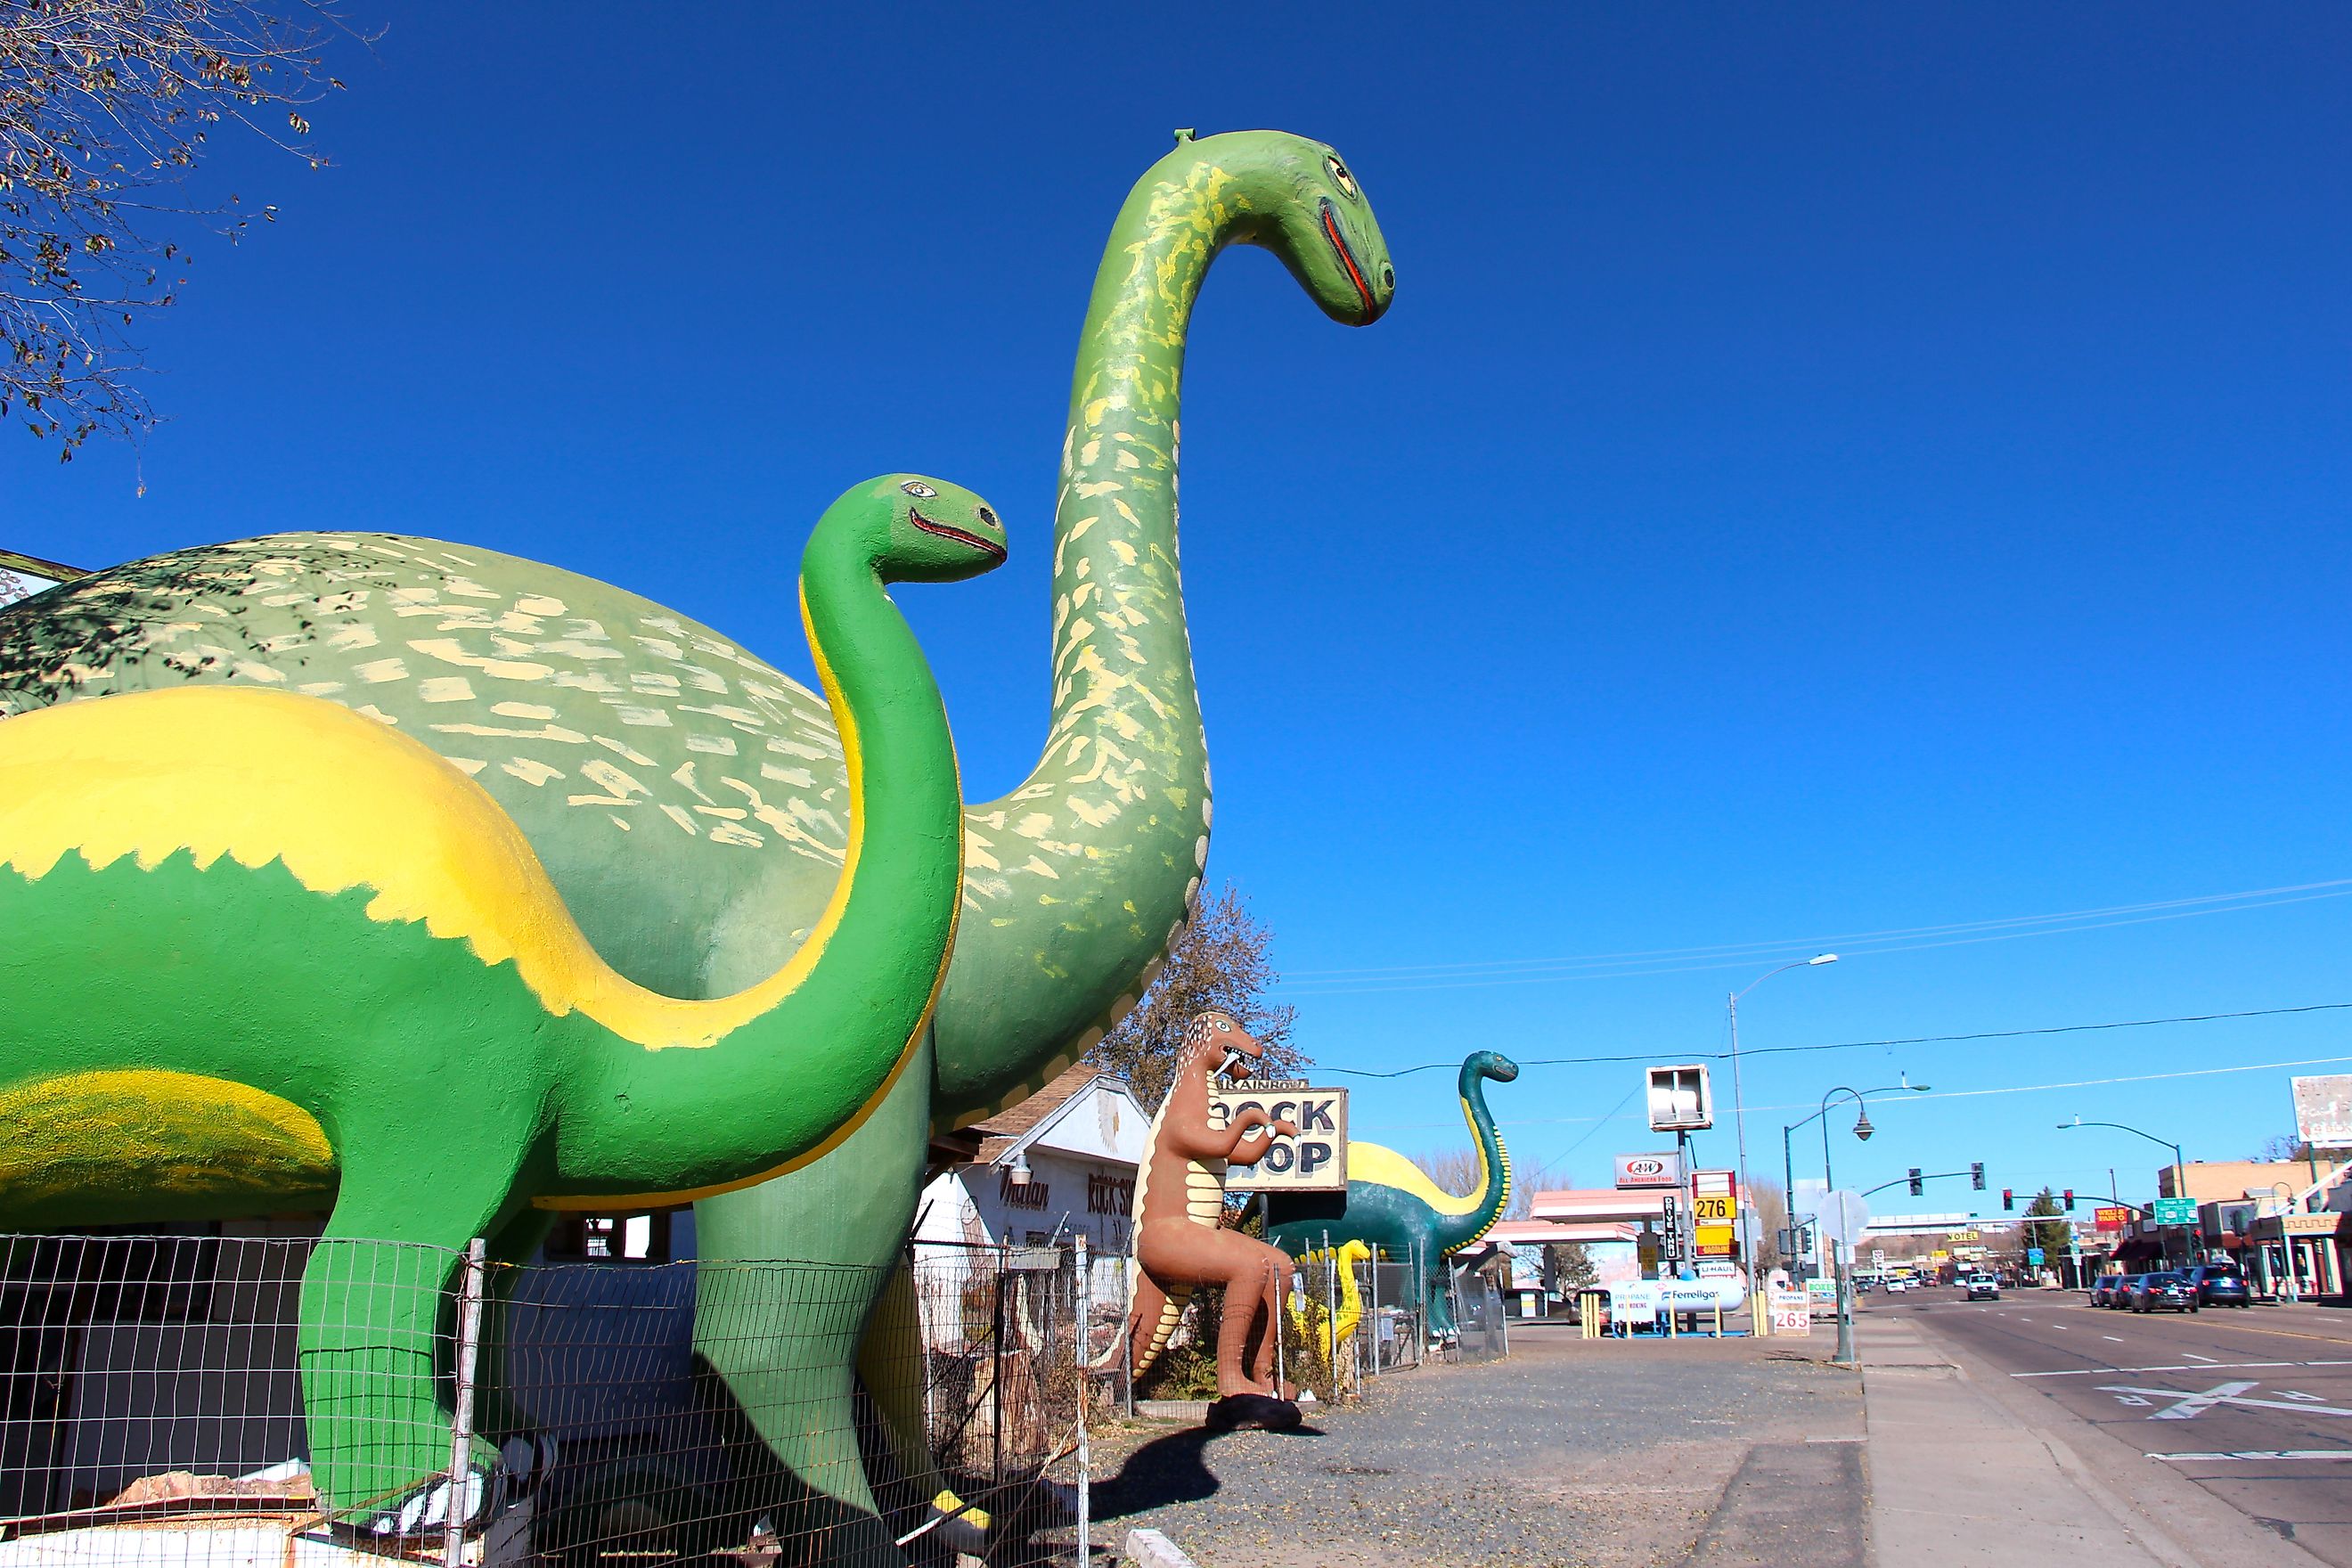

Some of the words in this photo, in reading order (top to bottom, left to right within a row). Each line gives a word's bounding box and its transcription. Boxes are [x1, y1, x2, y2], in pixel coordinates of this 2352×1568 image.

[1225, 1079, 1303, 1090] RAINBOW
[1664, 1196, 1674, 1229] DRIVE
[1696, 1199, 1726, 1218] 276
[1666, 1231, 1676, 1257] THRU
[1809, 1283, 1836, 1291] BOXES
[1672, 1290, 1719, 1301] Ferrellgas
[1776, 1312, 1808, 1327] 265
